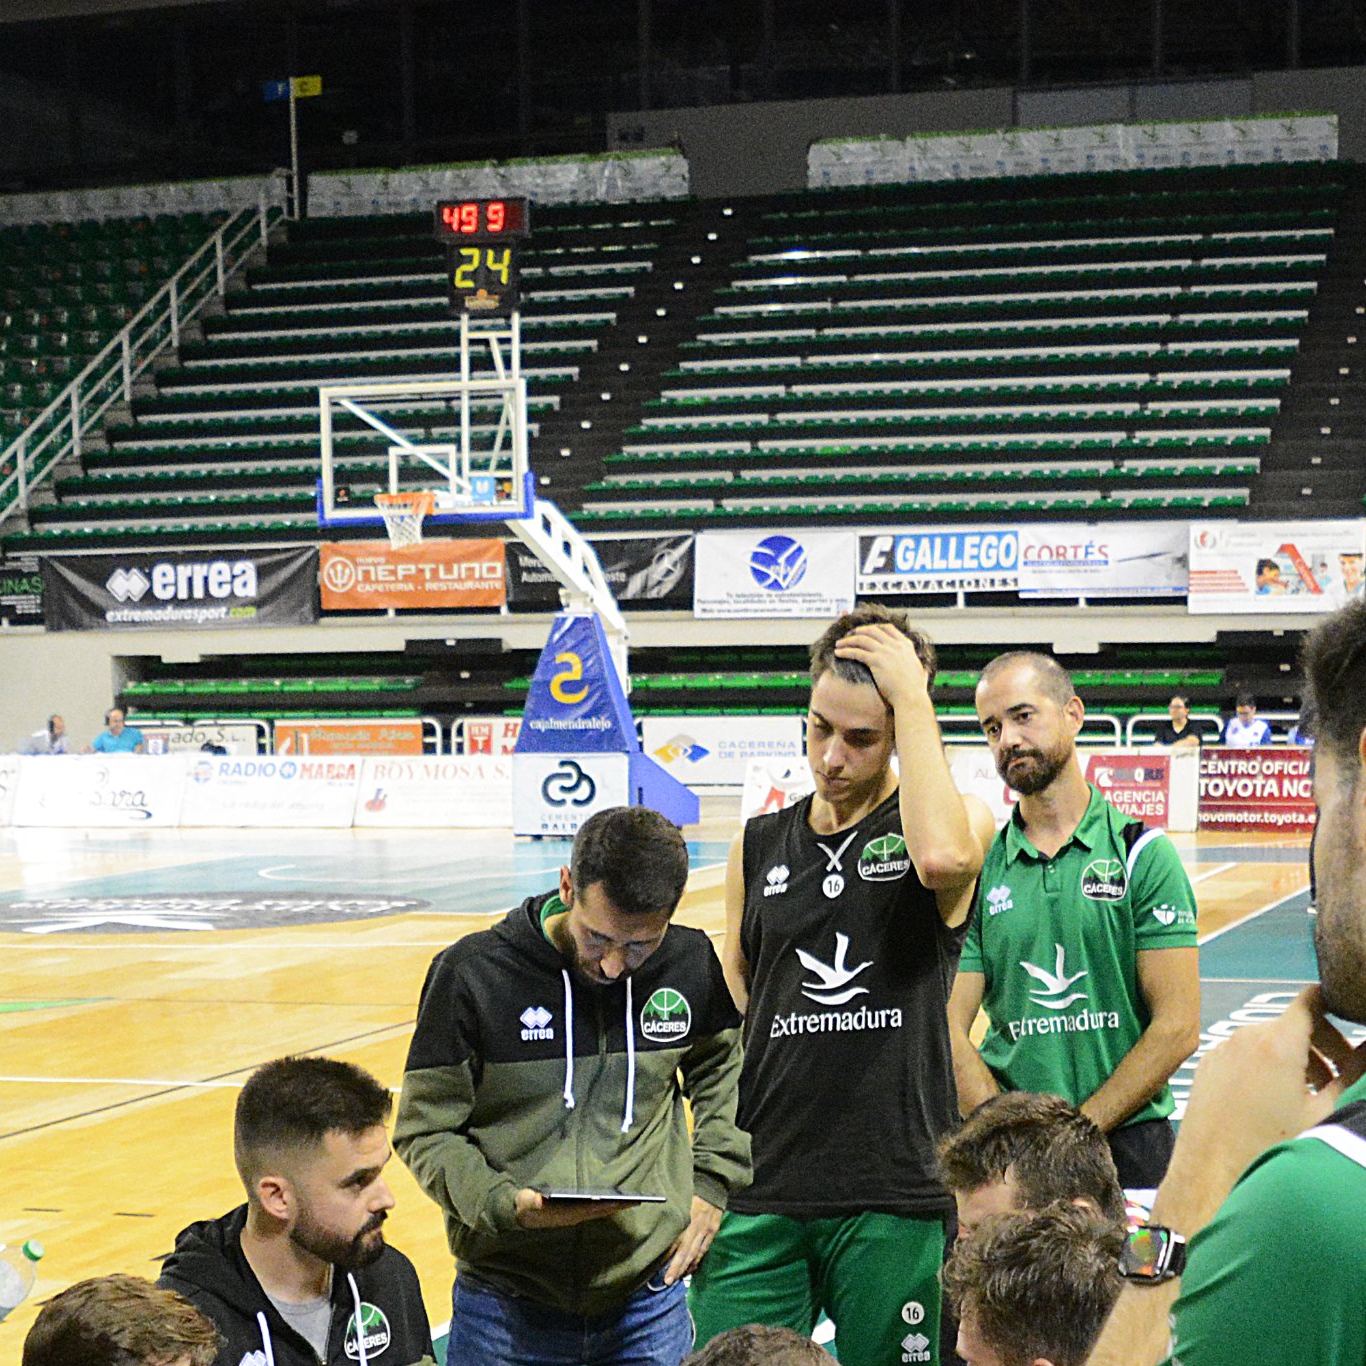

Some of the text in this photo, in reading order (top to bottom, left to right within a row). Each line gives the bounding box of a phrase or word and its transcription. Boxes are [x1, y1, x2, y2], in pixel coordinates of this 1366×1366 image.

[454, 247, 511, 288] 24
[896, 534, 1018, 571] GALLEGO
[1023, 541, 1109, 560] CORTÉS
[151, 560, 257, 600] errea
[105, 606, 257, 623] extremadurasport.com
[529, 718, 611, 731] cajalmendralejo
[218, 762, 356, 780] RADIO MARCA
[1199, 760, 1259, 776] CENTRO
[1199, 779, 1280, 798] TOYOTA
[1103, 792, 1165, 803] AGENCIA
[1199, 812, 1316, 824] novomotor.toyota.e
[827, 880, 840, 894] 16
[644, 1020, 686, 1033] CÁCERES
[770, 1006, 903, 1038] Extremadura
[1009, 1008, 1119, 1041] Etremadura
[521, 1028, 554, 1041] errea
[906, 1307, 920, 1320] 16
[901, 1351, 931, 1363] errea
